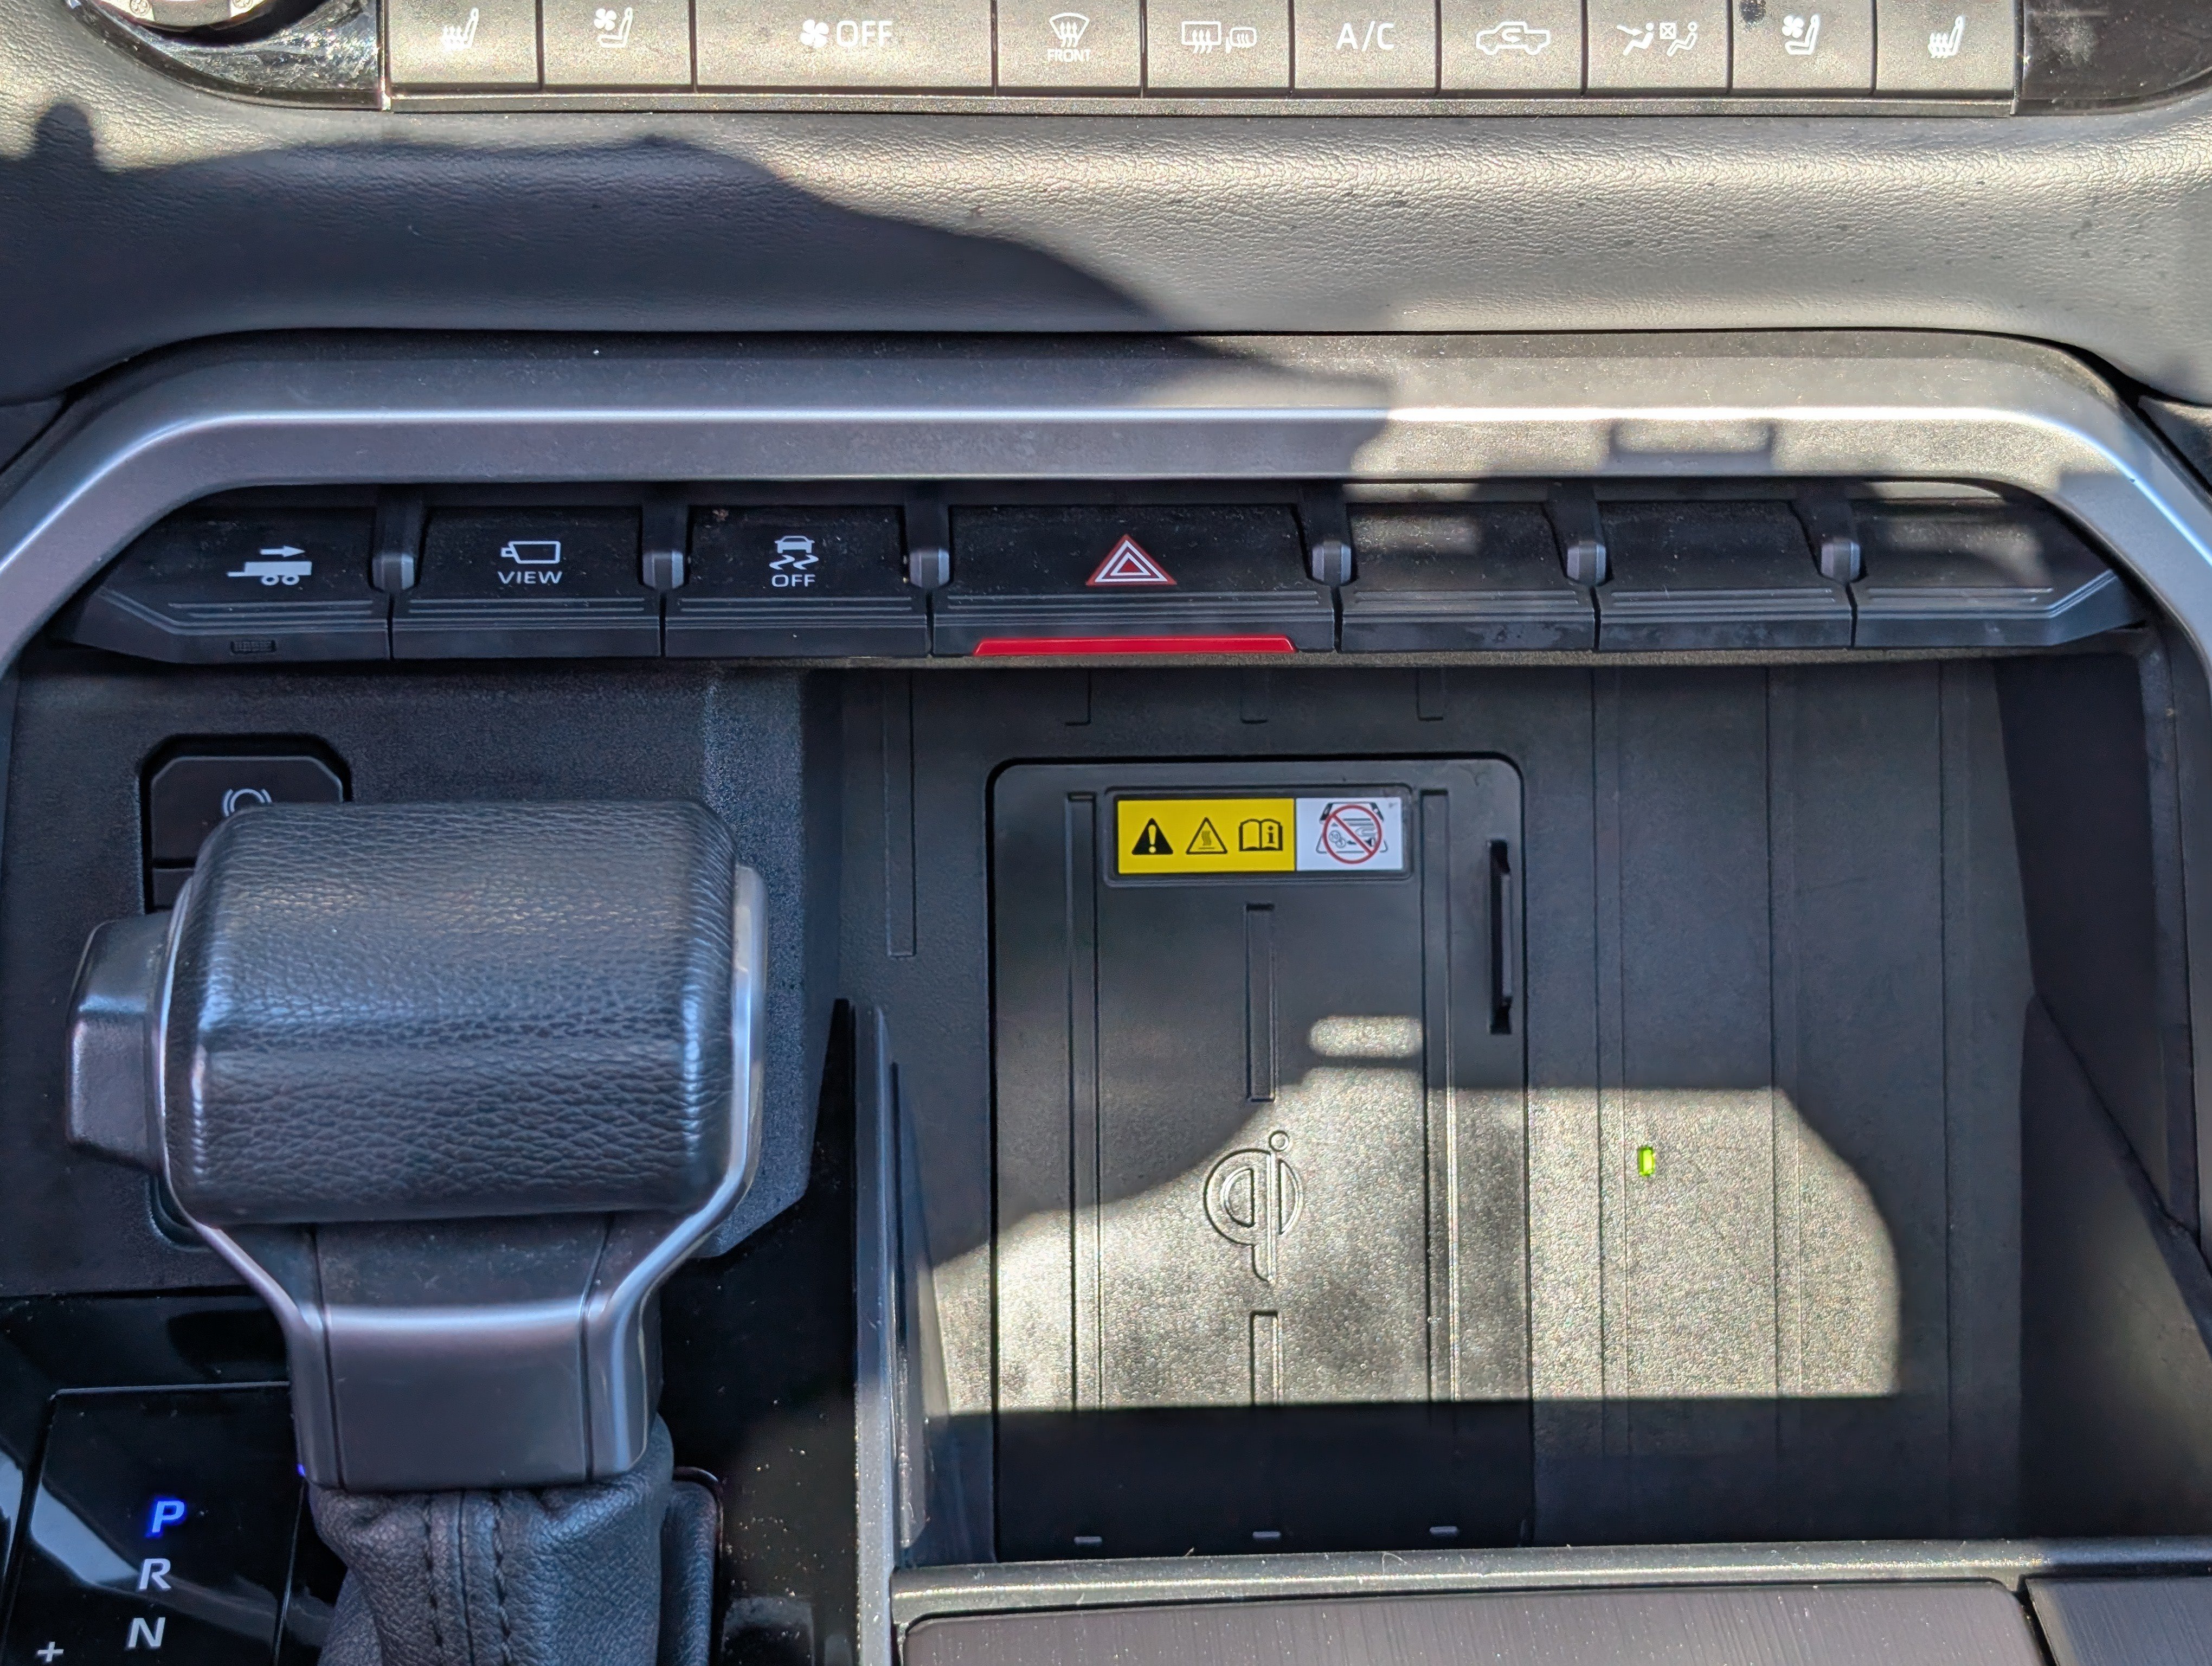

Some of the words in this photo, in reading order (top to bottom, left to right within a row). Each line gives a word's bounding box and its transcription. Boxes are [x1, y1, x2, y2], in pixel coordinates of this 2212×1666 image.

[836, 20, 893, 48] OFF
[1335, 21, 1395, 52] A/C
[1047, 49, 1090, 62] FRONT
[497, 571, 563, 584] VIEW
[771, 574, 816, 587] OFF
[149, 1498, 186, 1535] P
[138, 1558, 172, 1591] R
[127, 1617, 166, 1649] N
